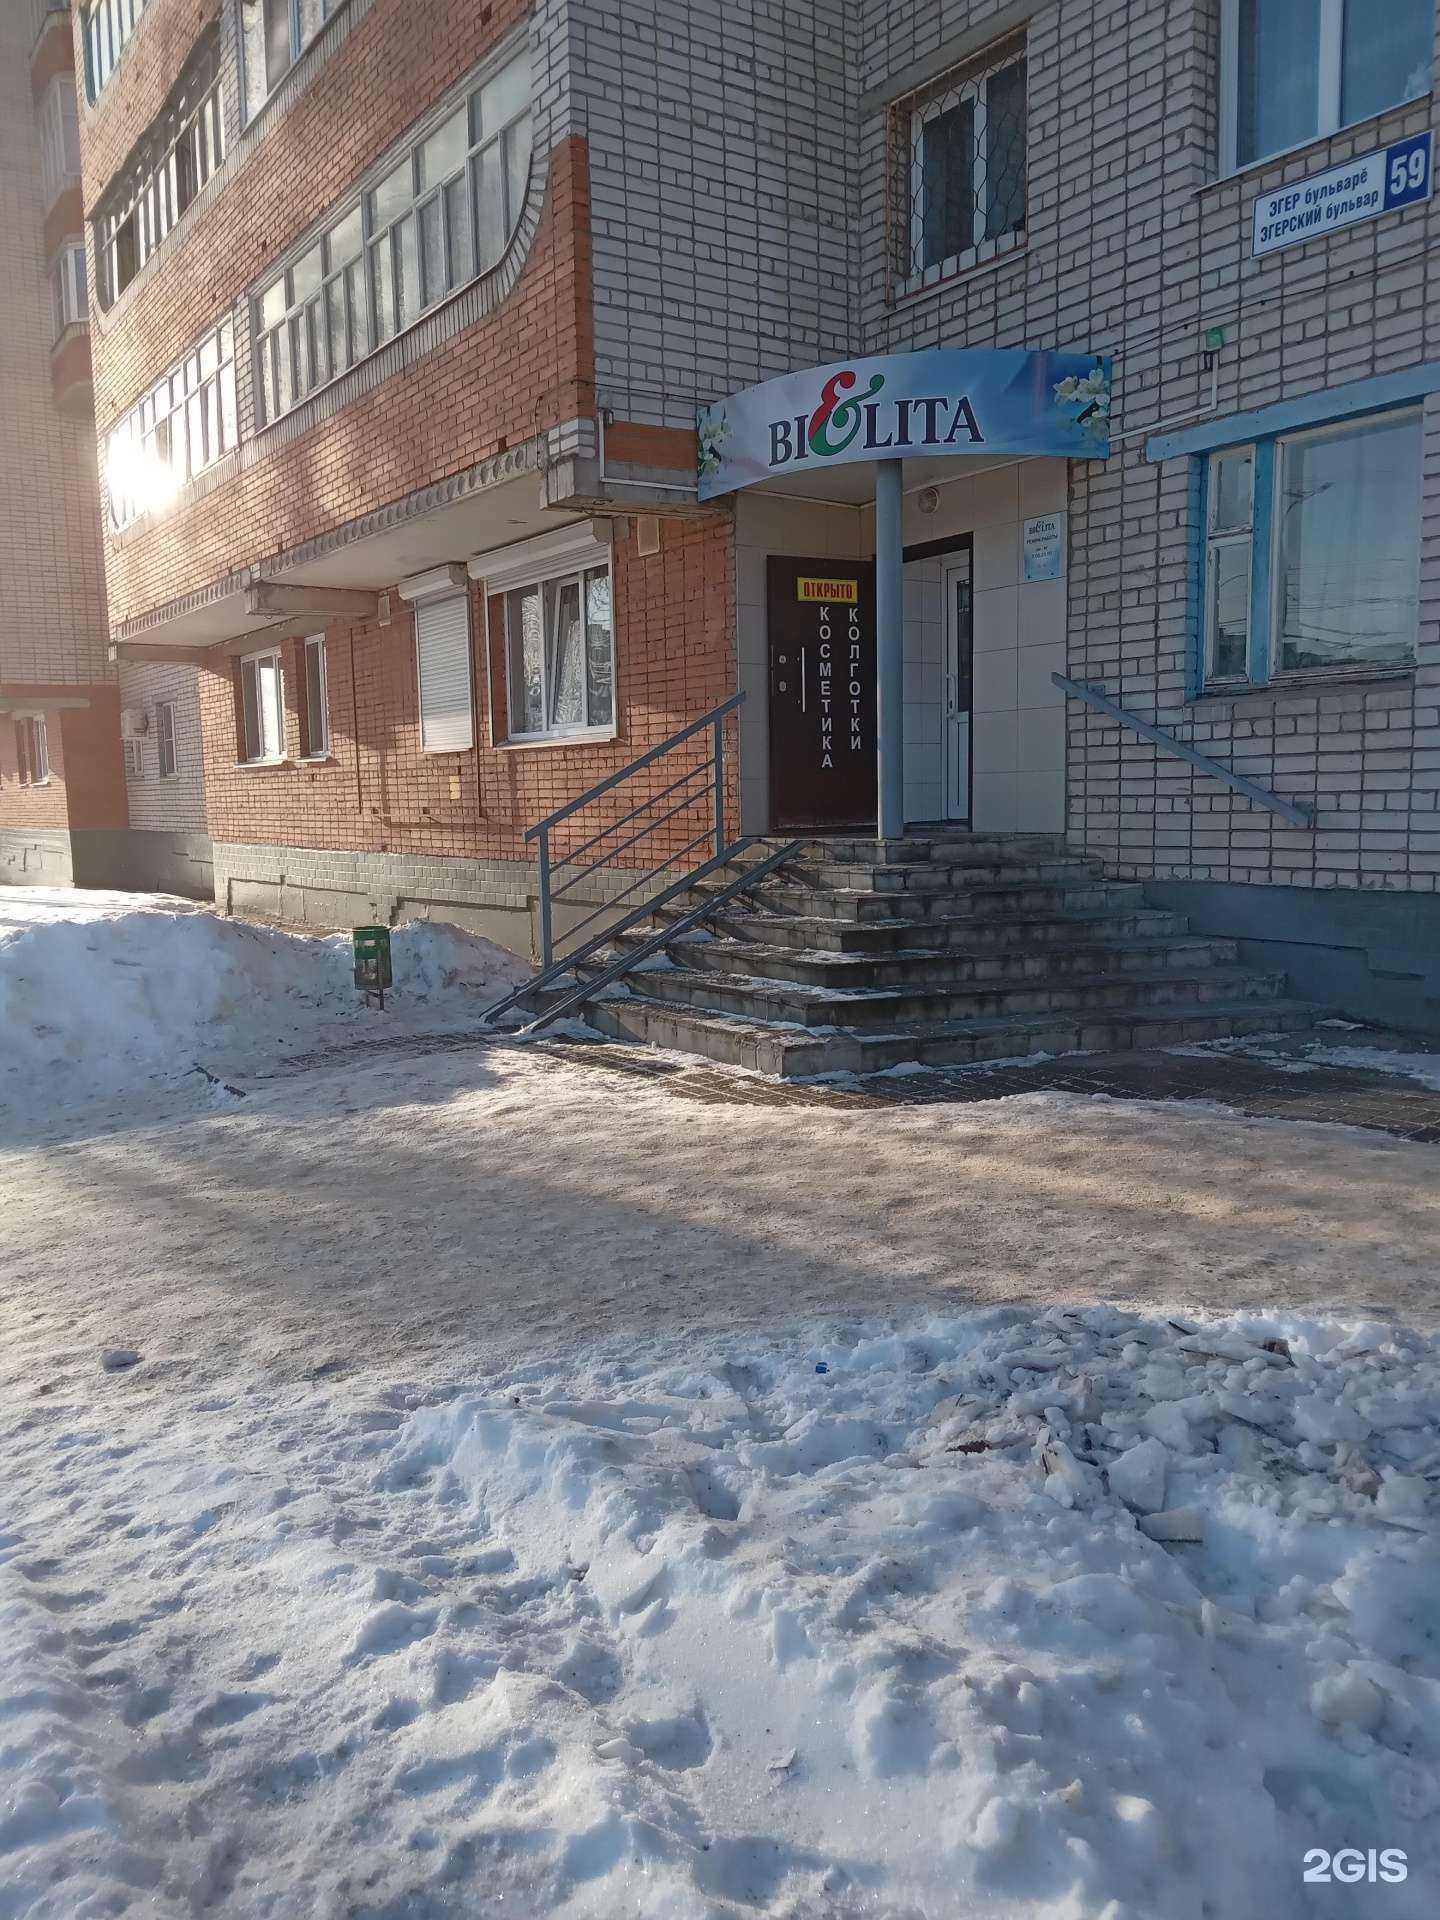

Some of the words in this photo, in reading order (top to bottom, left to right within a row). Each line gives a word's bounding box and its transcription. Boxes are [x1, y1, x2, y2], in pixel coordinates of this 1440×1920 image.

[1390, 149, 1426, 195] 59
[1260, 205, 1322, 242] ЭГЕРСКИЙ
[1326, 190, 1379, 220] бульвар
[1269, 193, 1300, 217] ЭГЕР
[803, 582, 853, 599] ОТКРЫТО
[819, 606, 832, 769] КОСМЕТИКА
[848, 607, 861, 750] КОЛГОТКИ
